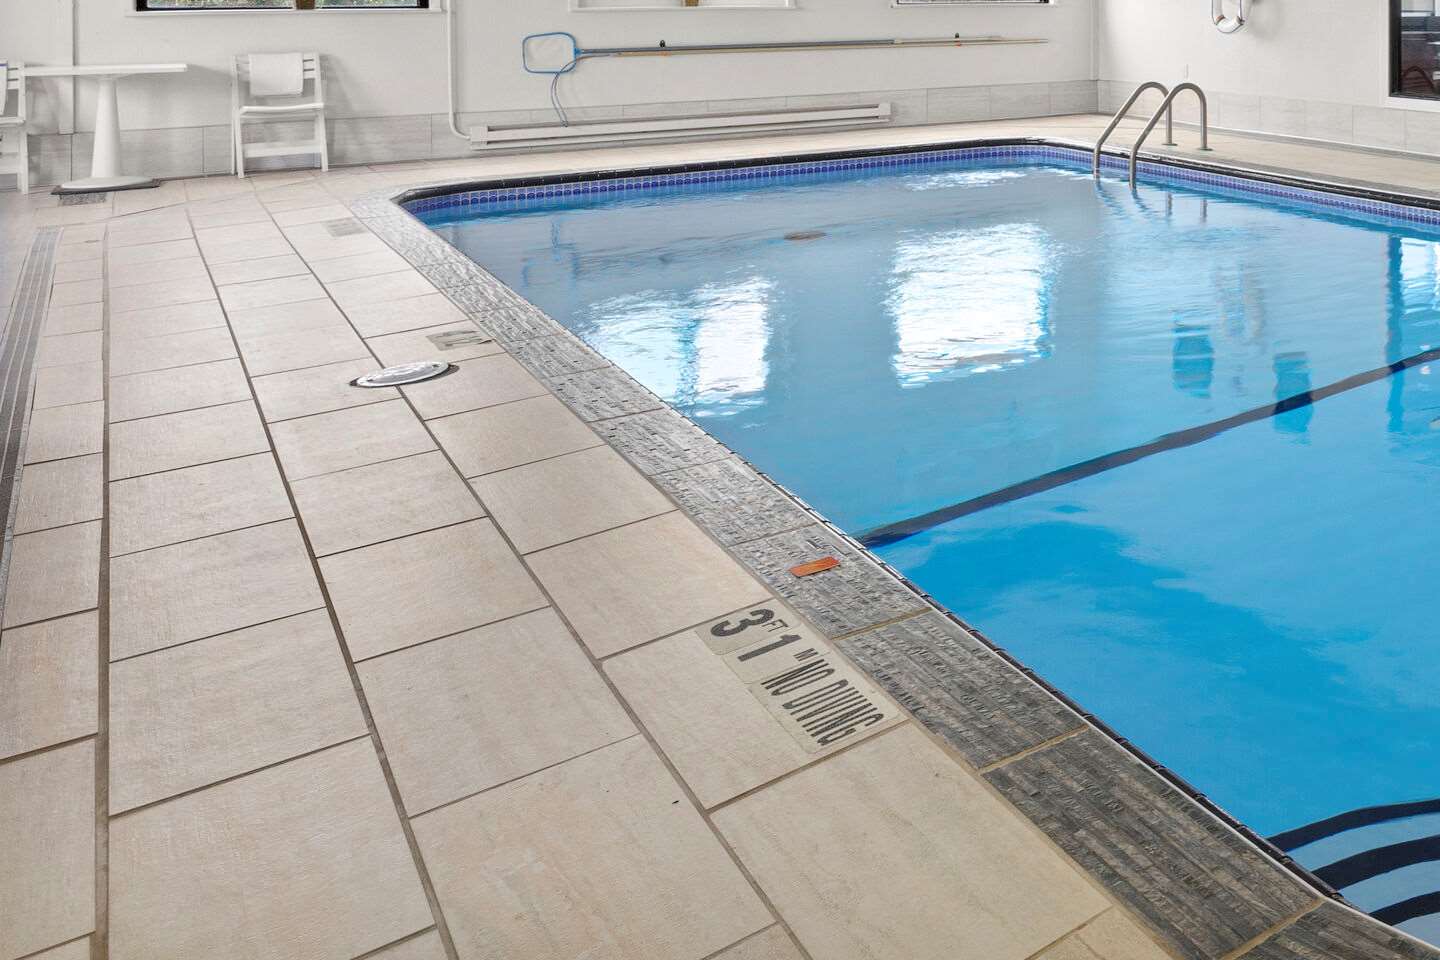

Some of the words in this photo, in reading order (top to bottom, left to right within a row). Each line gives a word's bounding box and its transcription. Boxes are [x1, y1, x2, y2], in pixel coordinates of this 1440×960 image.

[710, 608, 775, 637] 3
[737, 634, 802, 662] 1
[760, 659, 835, 696] NO
[781, 679, 884, 746] DIVING
